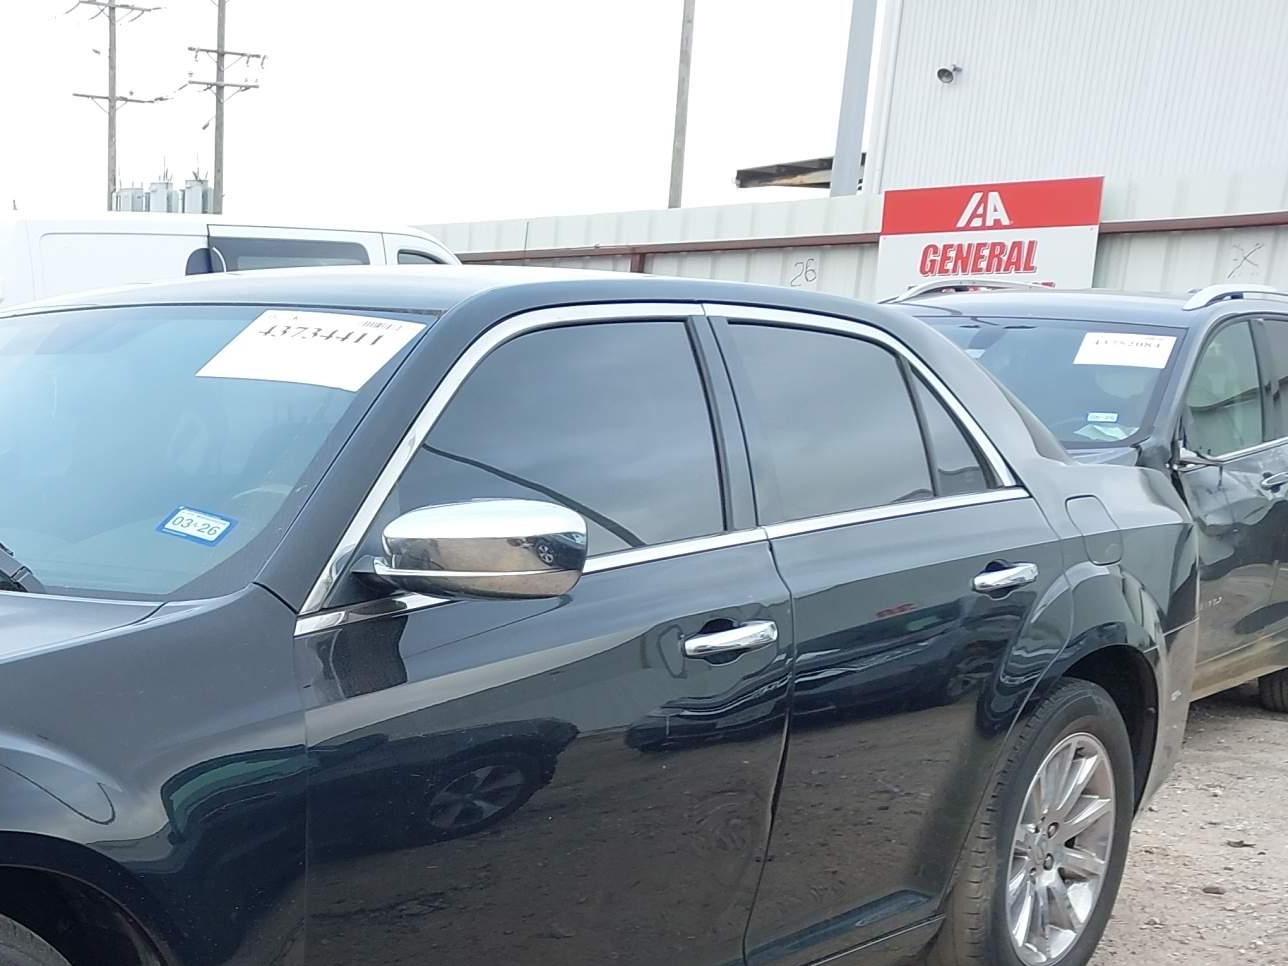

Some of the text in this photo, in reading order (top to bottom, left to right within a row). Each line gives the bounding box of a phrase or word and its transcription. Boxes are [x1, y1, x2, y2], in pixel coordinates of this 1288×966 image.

[790, 258, 817, 287] 26
[919, 240, 1038, 277] GENERAL
[258, 324, 385, 346] 43734411
